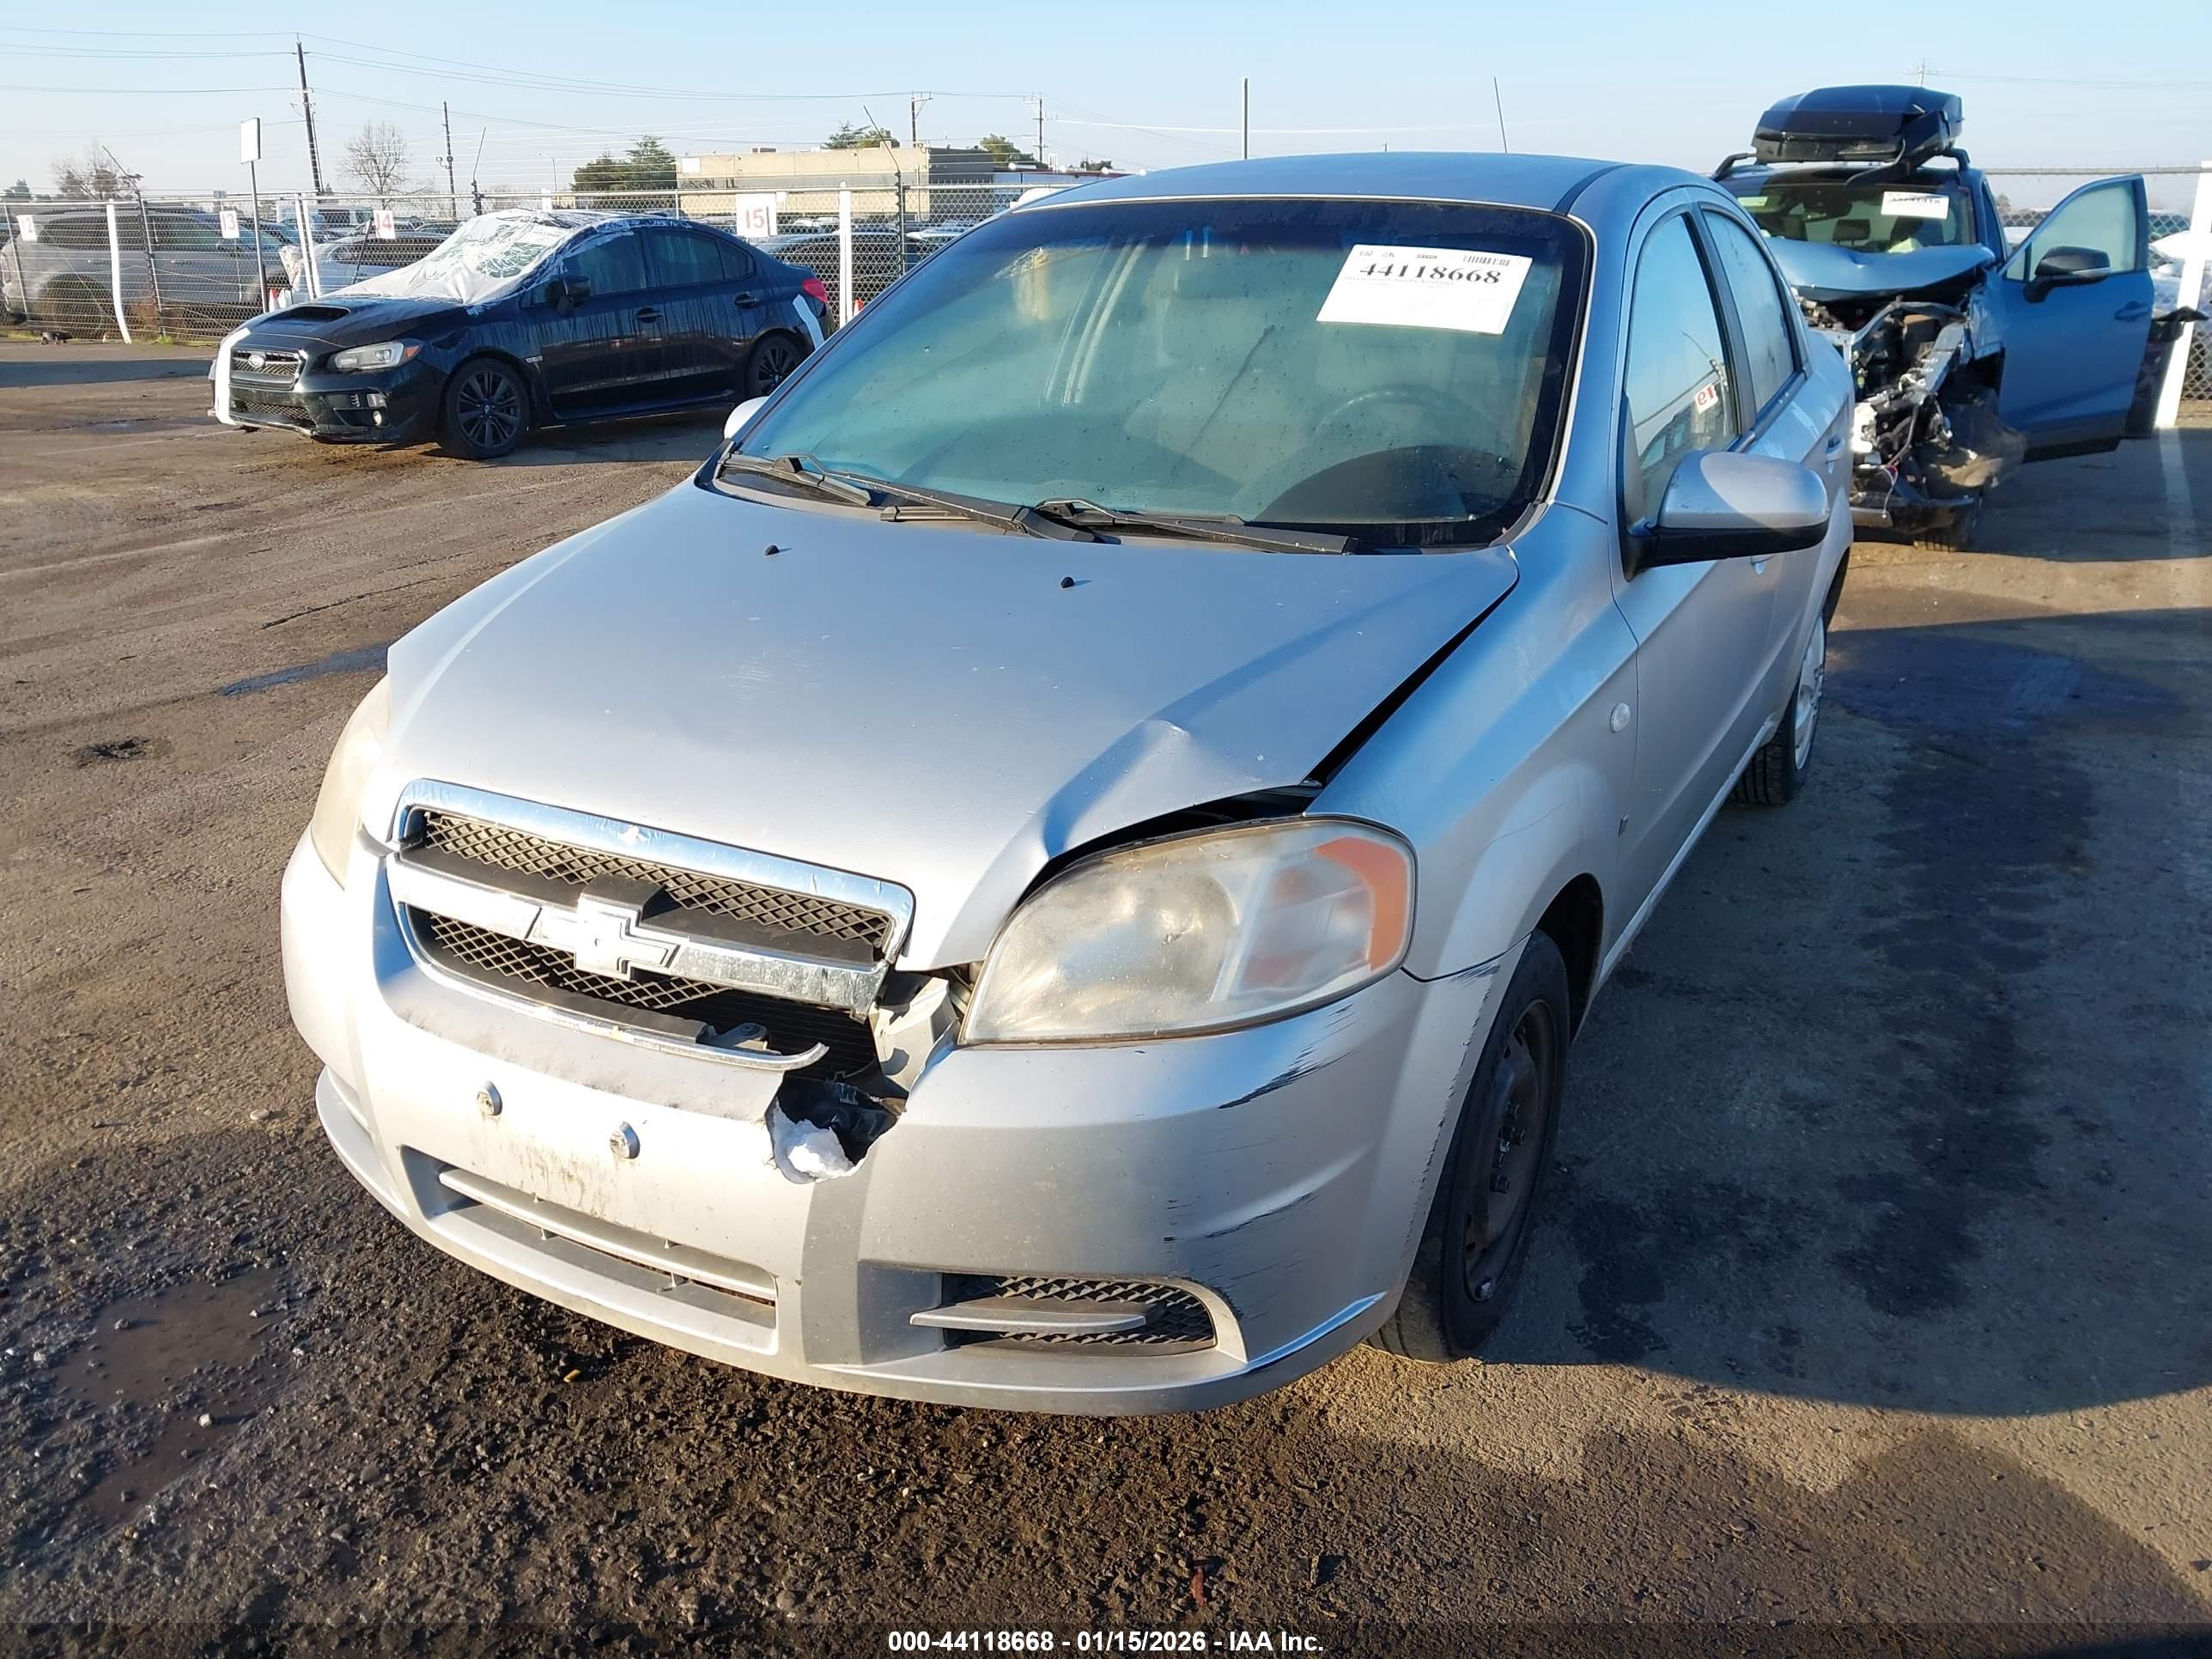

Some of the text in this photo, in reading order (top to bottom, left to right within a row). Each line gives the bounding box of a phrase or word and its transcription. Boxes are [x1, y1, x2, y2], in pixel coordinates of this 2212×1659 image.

[222, 213, 236, 231] 13
[375, 213, 392, 231] 14
[744, 208, 765, 229] 15
[1359, 263, 1502, 284] 44118668
